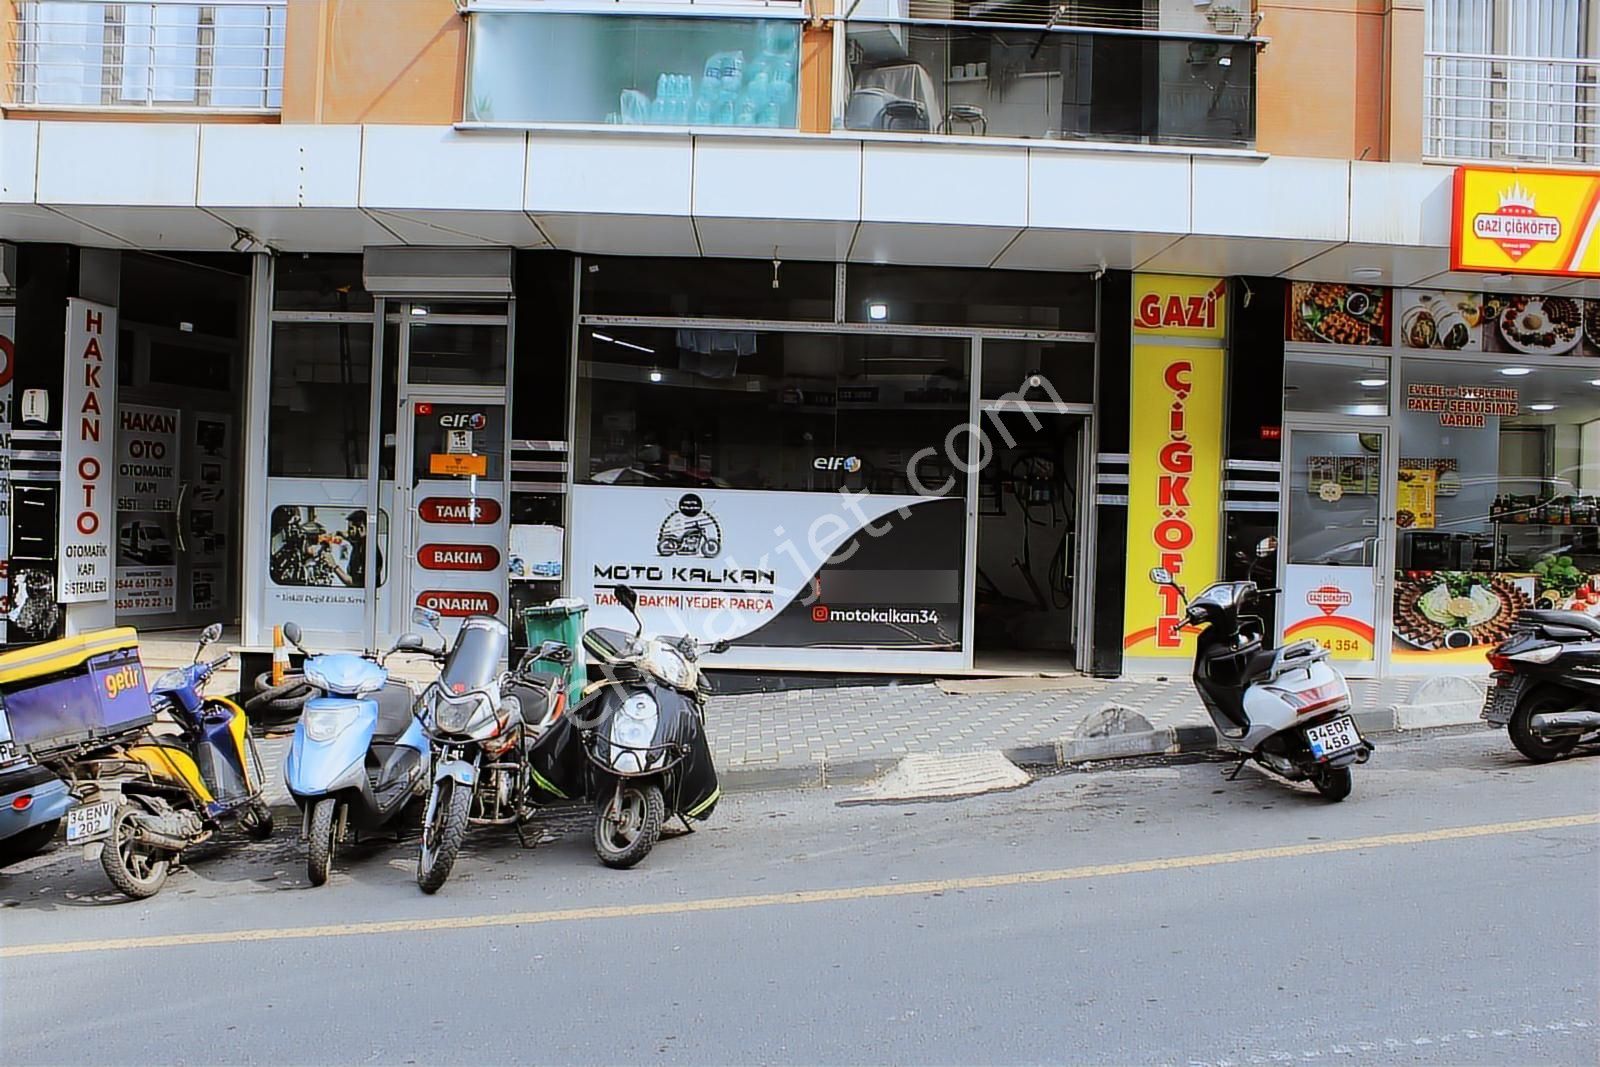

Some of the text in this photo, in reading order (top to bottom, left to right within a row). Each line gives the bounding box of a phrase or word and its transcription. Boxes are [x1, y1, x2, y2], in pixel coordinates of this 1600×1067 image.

[1477, 218, 1502, 233] GAZİ
[1140, 290, 1216, 329] GAZİ
[1408, 384, 1445, 396] EVLERE
[1408, 399, 1447, 411] PAKET
[77, 309, 103, 535] HAKAN OTO
[120, 411, 176, 434] HAKAN
[439, 413, 469, 428] elf
[1440, 414, 1485, 427] VARDIR
[129, 440, 166, 459] OTO
[813, 456, 844, 470] elf
[434, 551, 483, 564] BAKIM
[593, 564, 775, 585] MOTO KALKAN
[426, 597, 489, 611] ONARIM
[639, 595, 680, 608] BAKIM
[686, 596, 726, 610] YEDEK
[730, 597, 774, 614] PARÇA
[830, 608, 938, 624] motokalkan34
[1335, 639, 1359, 651] 354
[104, 665, 139, 699] getir
[1325, 734, 1350, 751] 458
